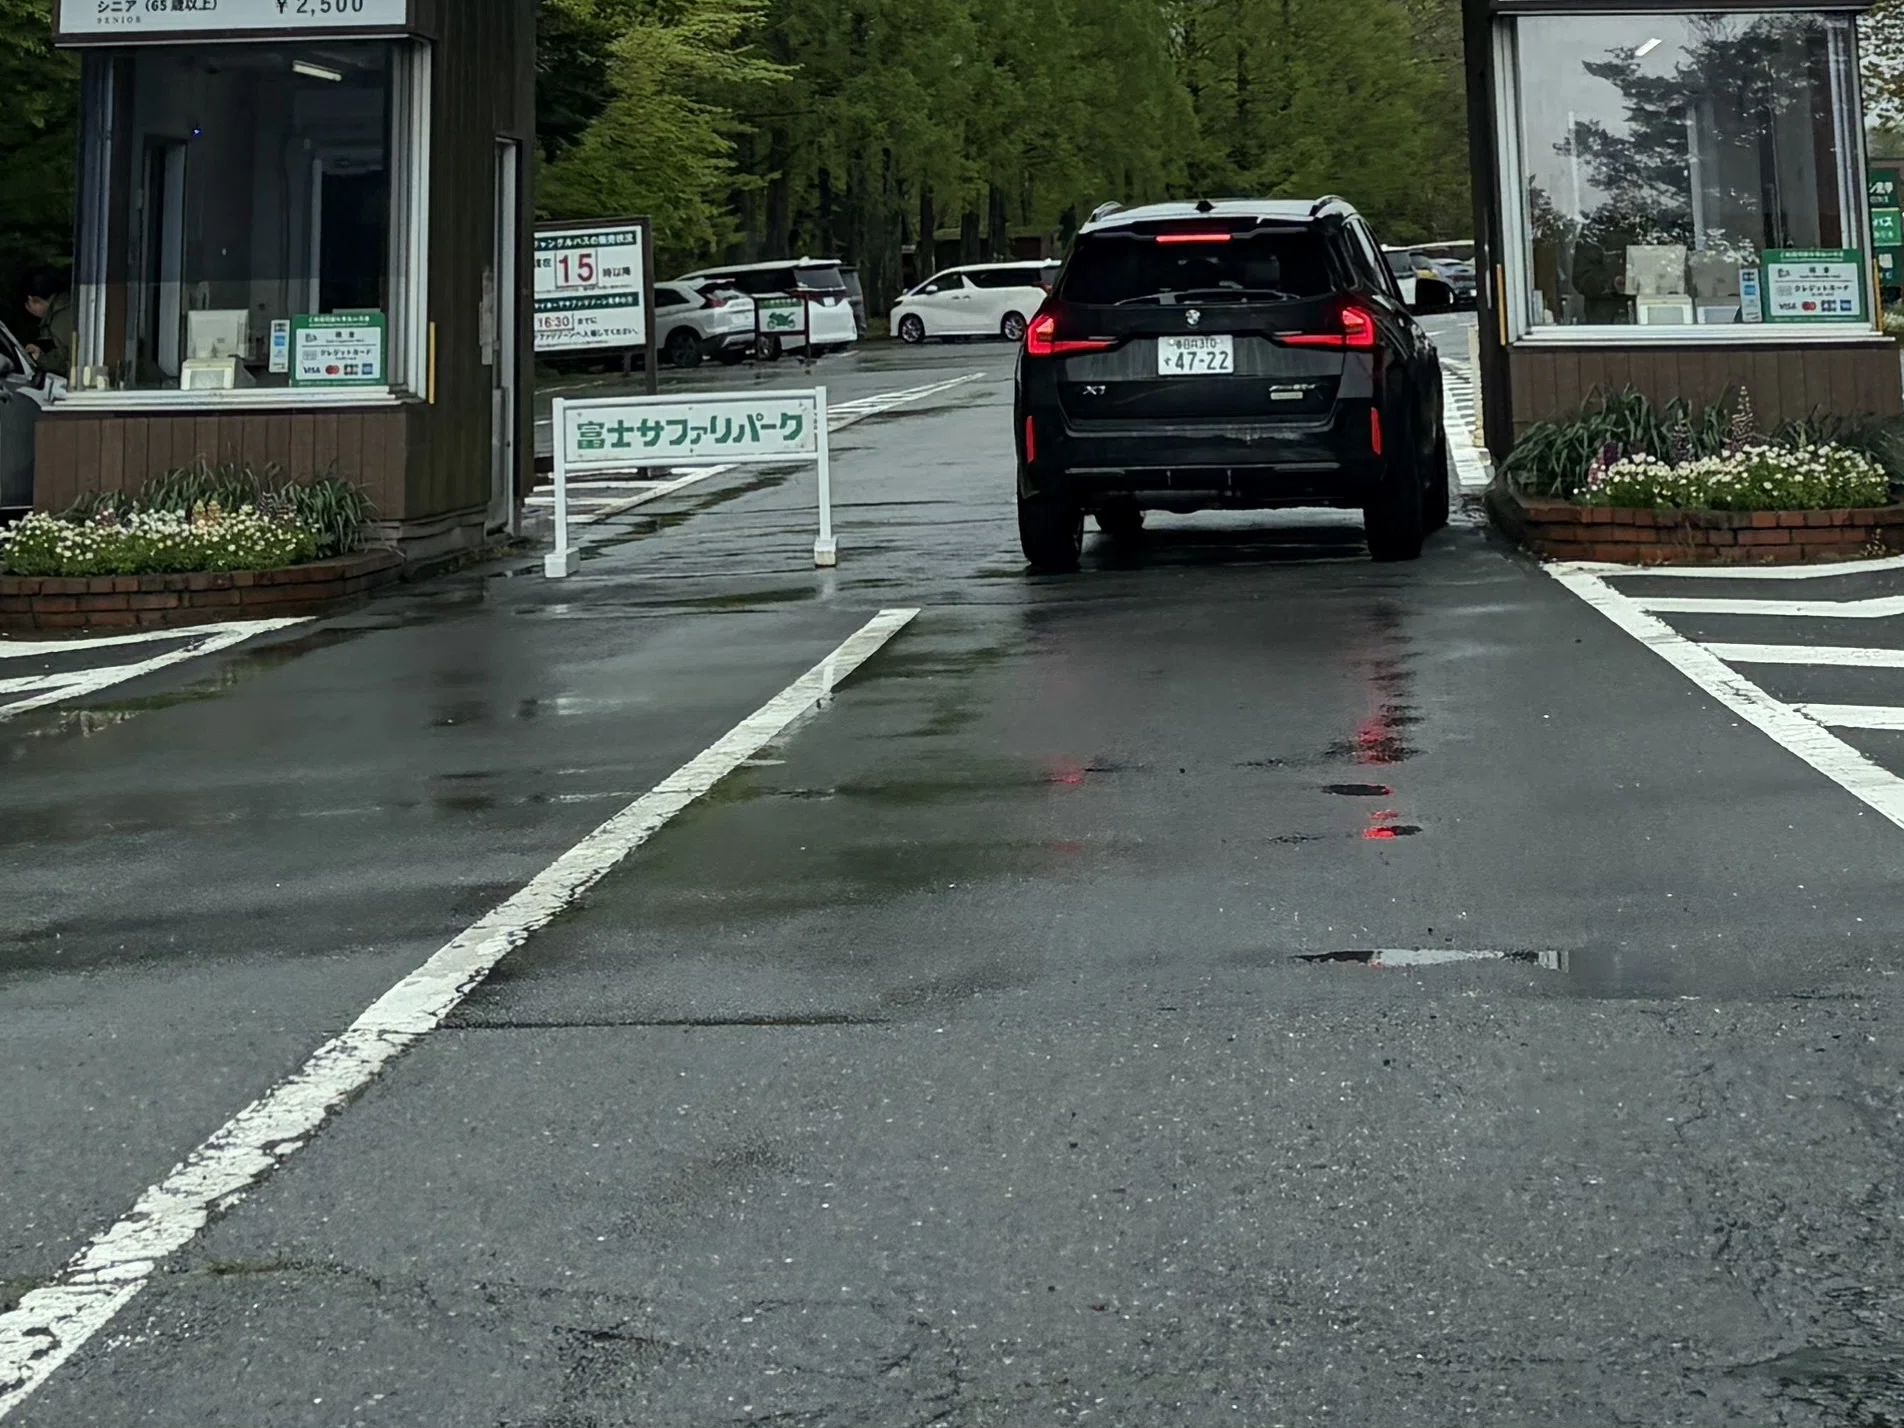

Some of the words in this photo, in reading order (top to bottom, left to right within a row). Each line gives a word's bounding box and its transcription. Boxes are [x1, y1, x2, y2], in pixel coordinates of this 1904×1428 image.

[558, 253, 594, 283] 15
[303, 366, 321, 374] VISA
[576, 412, 804, 450] 富士サファリパーク
